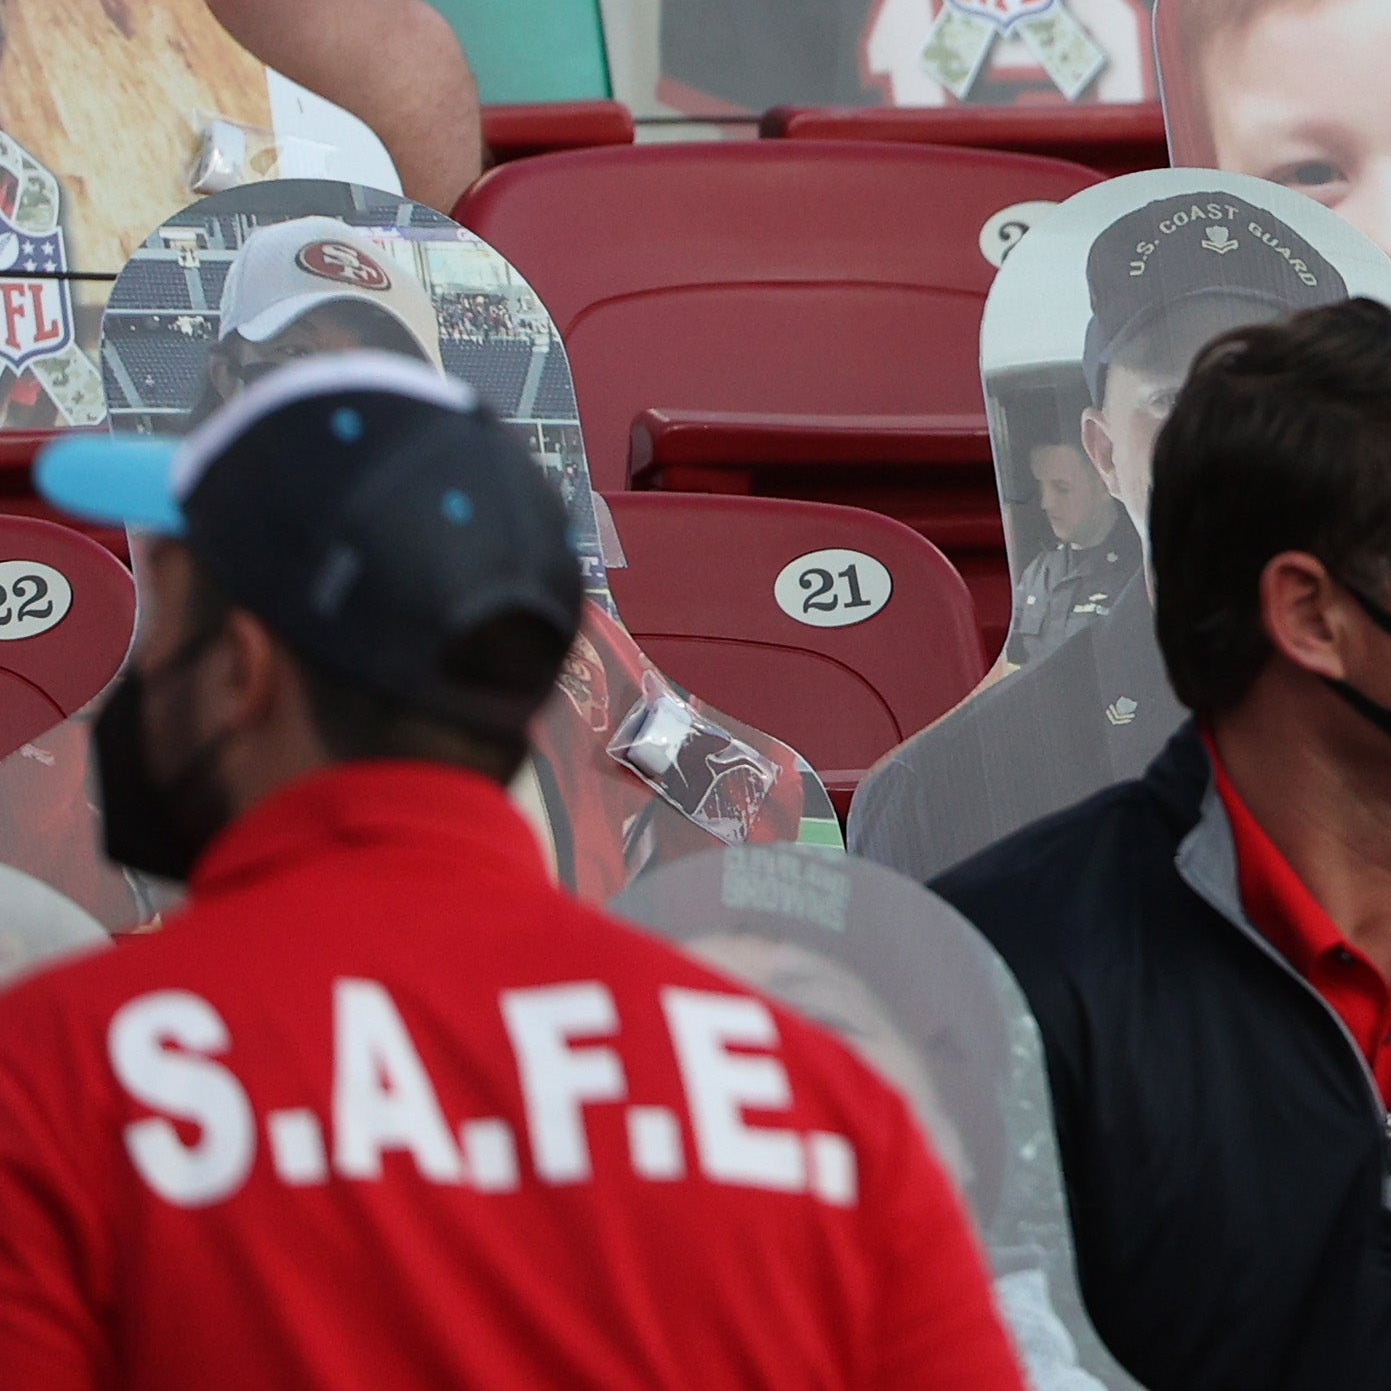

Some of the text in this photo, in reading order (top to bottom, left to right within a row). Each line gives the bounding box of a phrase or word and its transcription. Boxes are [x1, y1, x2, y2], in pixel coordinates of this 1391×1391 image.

[1128, 203, 1318, 288] U.S. COAST GUARD
[0, 280, 60, 352] FL
[798, 563, 872, 614] 21
[108, 976, 858, 1210] S.A.F.E.
